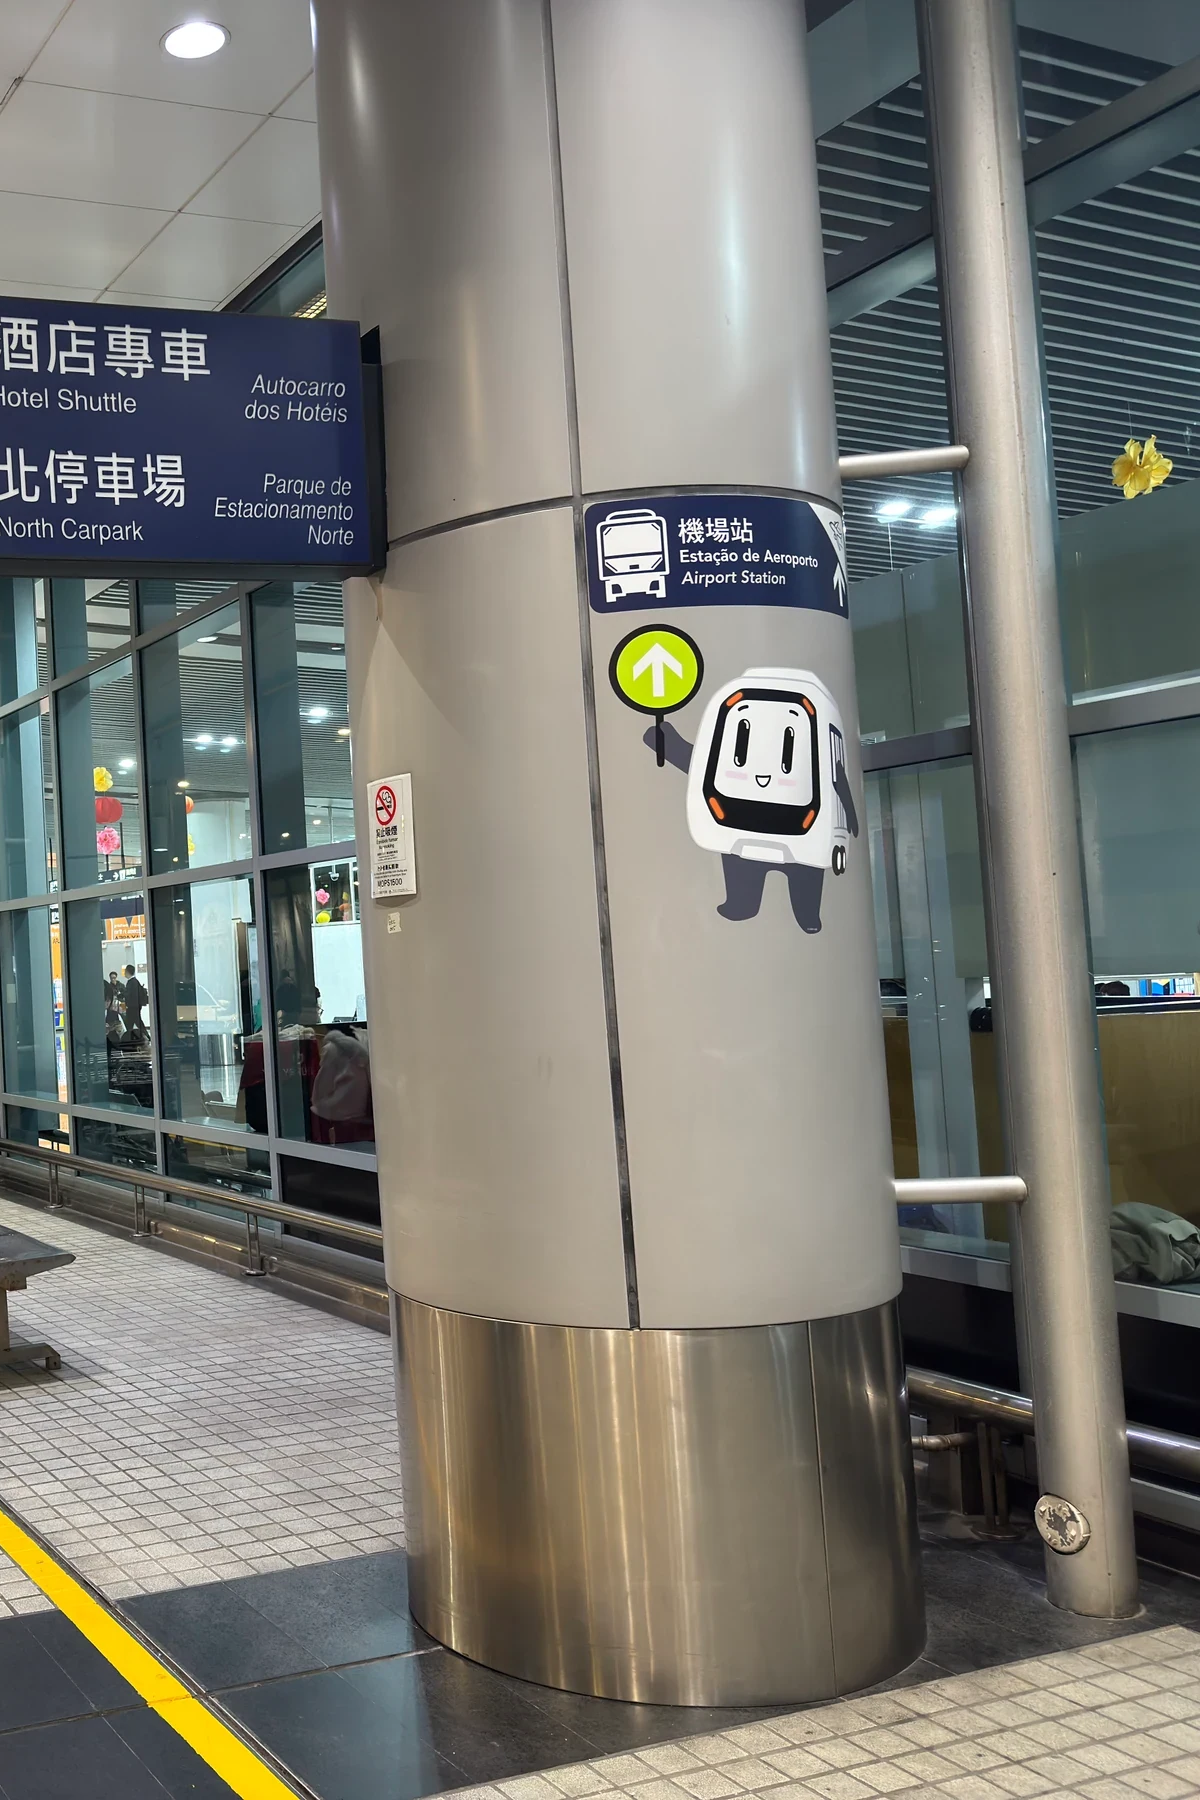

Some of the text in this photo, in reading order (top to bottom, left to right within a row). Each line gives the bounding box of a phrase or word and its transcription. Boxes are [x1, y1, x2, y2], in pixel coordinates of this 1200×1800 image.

[251, 374, 346, 397] Autocarro
[58, 388, 137, 414] Shuttle
[244, 400, 348, 423] dos Hotéis
[263, 473, 352, 500] Parque de
[215, 496, 354, 522] Estacionamento
[62, 517, 144, 546] Carpark
[307, 524, 354, 546] Norte
[678, 518, 753, 544] 機場站
[680, 548, 819, 569] Estação de Aeroporto
[681, 569, 786, 588] Airport Station
